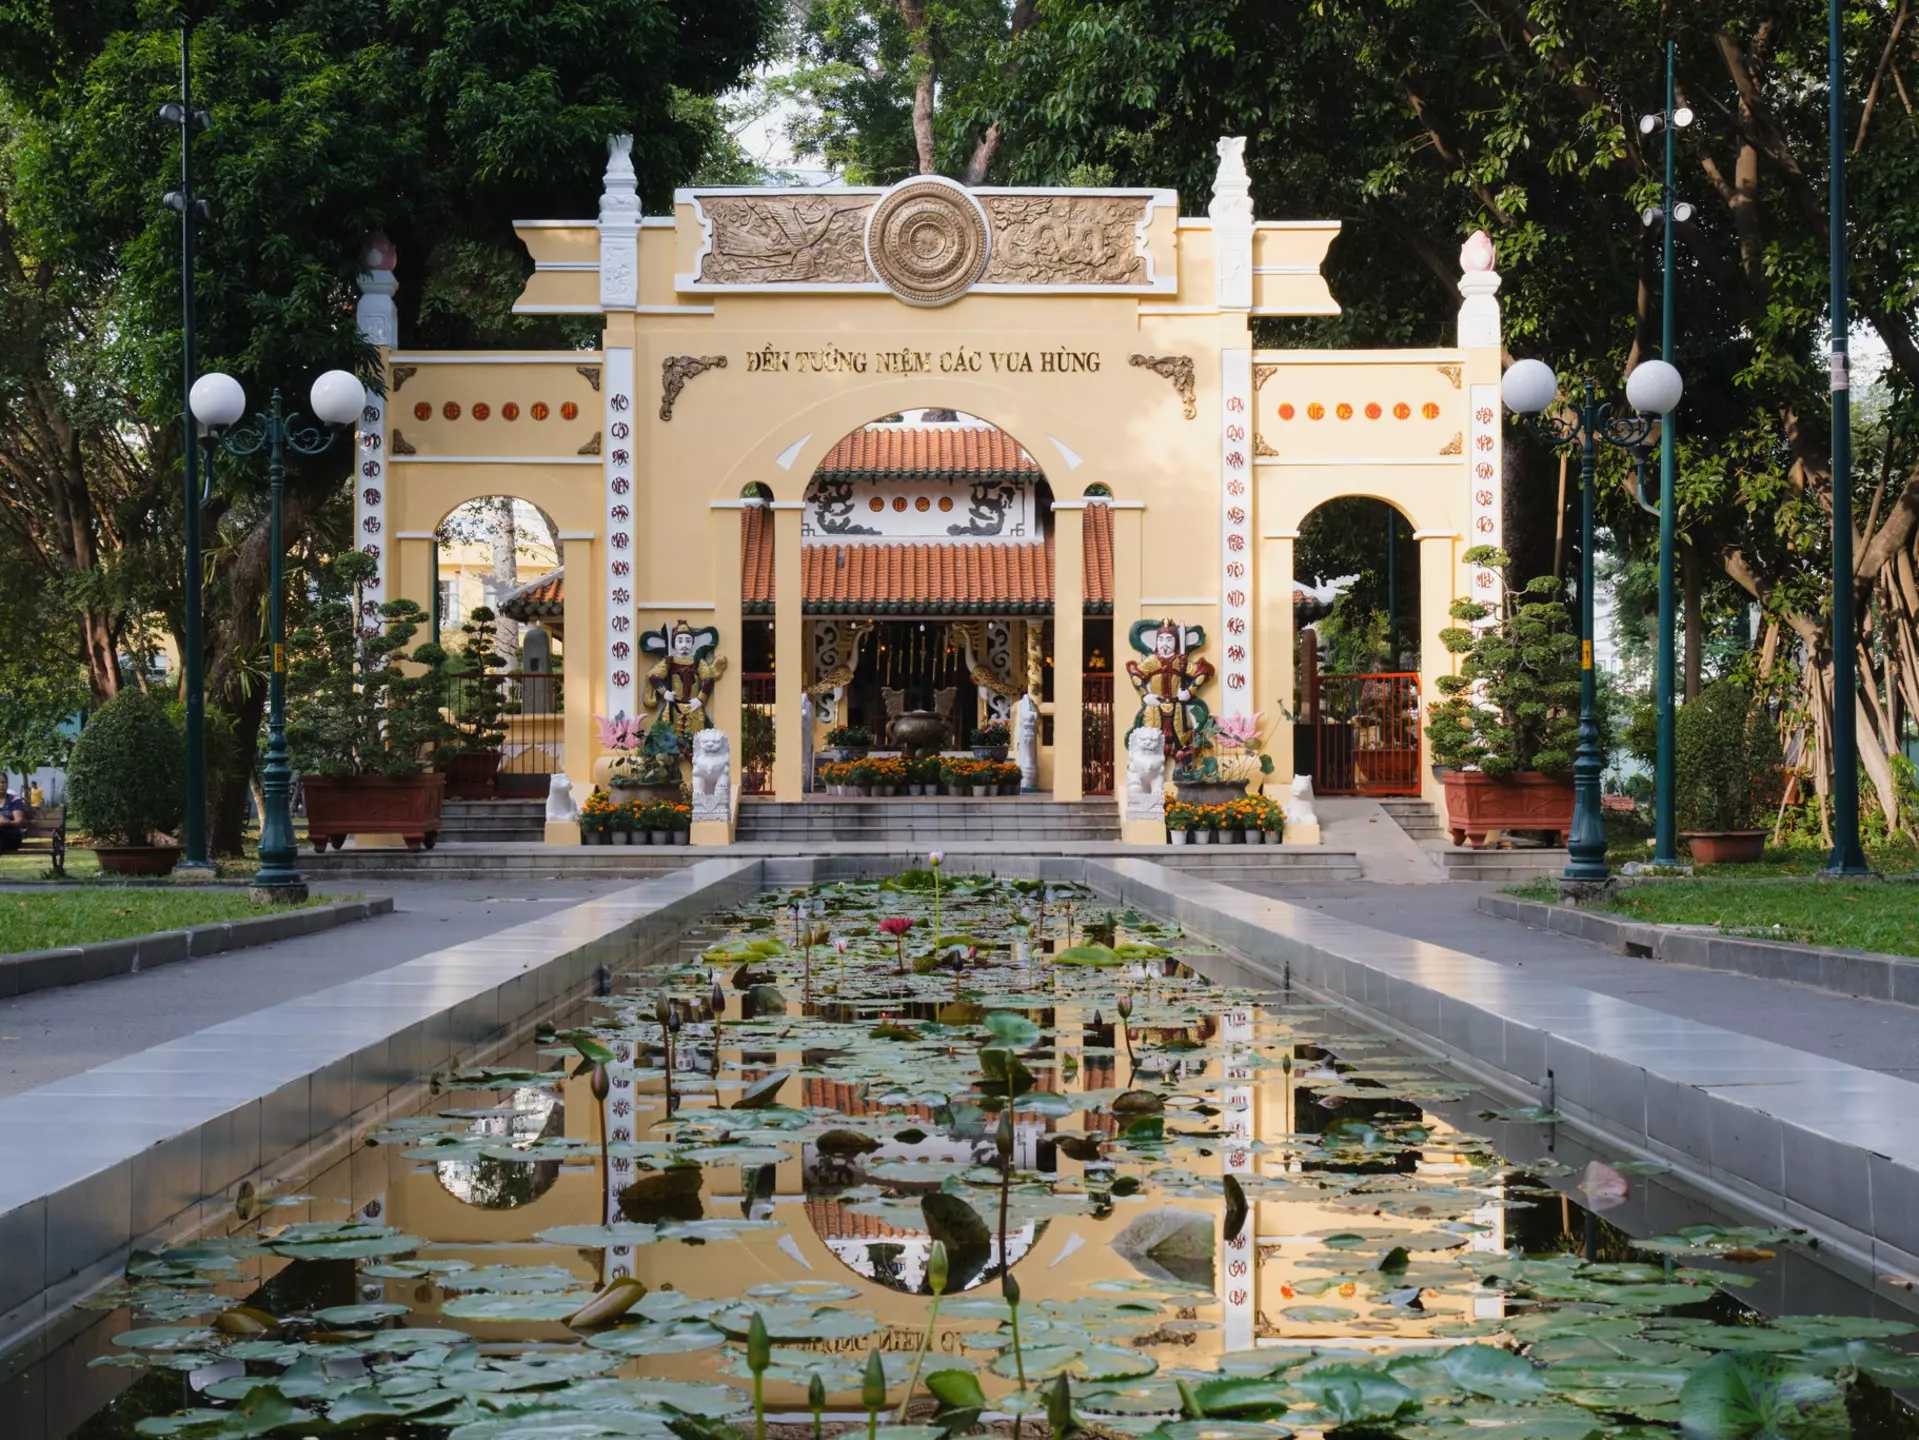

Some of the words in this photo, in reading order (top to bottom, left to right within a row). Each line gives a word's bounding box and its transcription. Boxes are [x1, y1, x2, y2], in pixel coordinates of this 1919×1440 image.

[746, 342, 790, 372] ĐỀN
[795, 342, 867, 372] TƯỞNG
[875, 347, 931, 377] NIỆM
[940, 345, 982, 372] CÁC
[989, 351, 1033, 372] VUA
[1040, 345, 1101, 372] HÙNG
